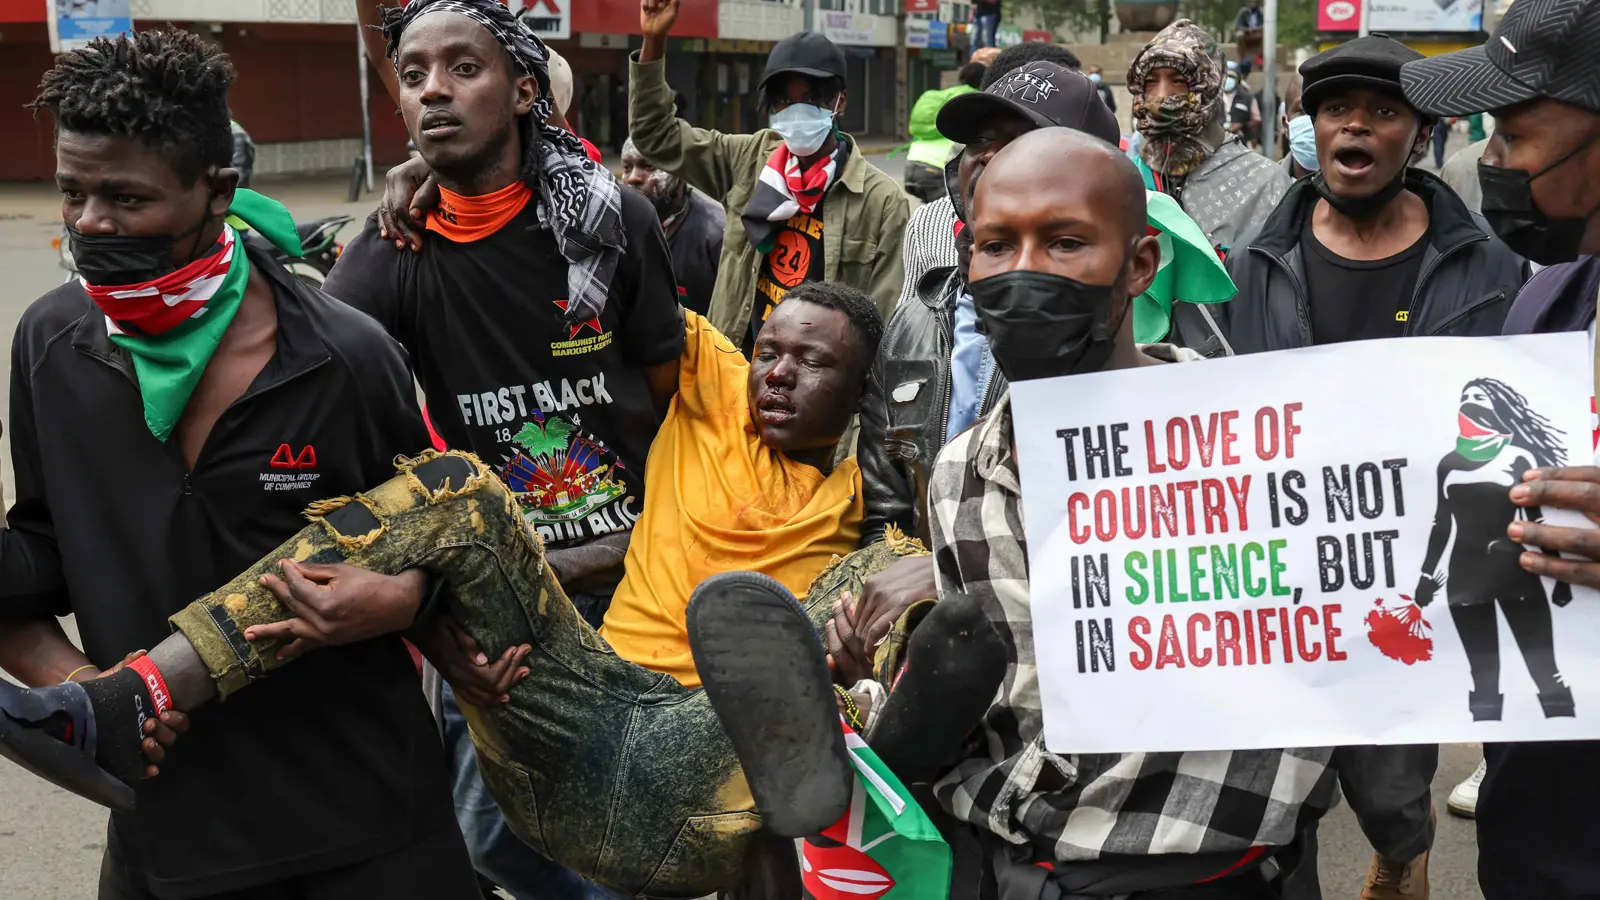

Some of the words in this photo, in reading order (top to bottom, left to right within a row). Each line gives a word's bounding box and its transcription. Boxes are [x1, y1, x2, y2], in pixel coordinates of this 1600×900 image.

[786, 214, 824, 240] ME
[776, 244, 802, 273] 24
[551, 337, 597, 349] COMMUNIST
[457, 385, 528, 426] FIRST
[532, 372, 613, 412] BLACK
[494, 428, 511, 443] 18
[1056, 423, 1132, 481] THE
[1144, 411, 1240, 473] LOVE
[1255, 403, 1302, 460] OF
[259, 473, 297, 482] MUNICIPAL
[297, 473, 320, 481] GROUP
[264, 482, 274, 491] OF
[275, 481, 312, 491] COMPANIES
[537, 496, 640, 544] PUBLIC
[1068, 475, 1251, 544] COUNTRY
[1267, 470, 1308, 528] IS
[1323, 458, 1407, 523] NOT
[1071, 554, 1110, 609] IN
[1125, 539, 1303, 604] SILENCE,
[1317, 530, 1399, 592] BUT
[1075, 618, 1115, 673] IN
[1128, 604, 1347, 670] SACRIFICE
